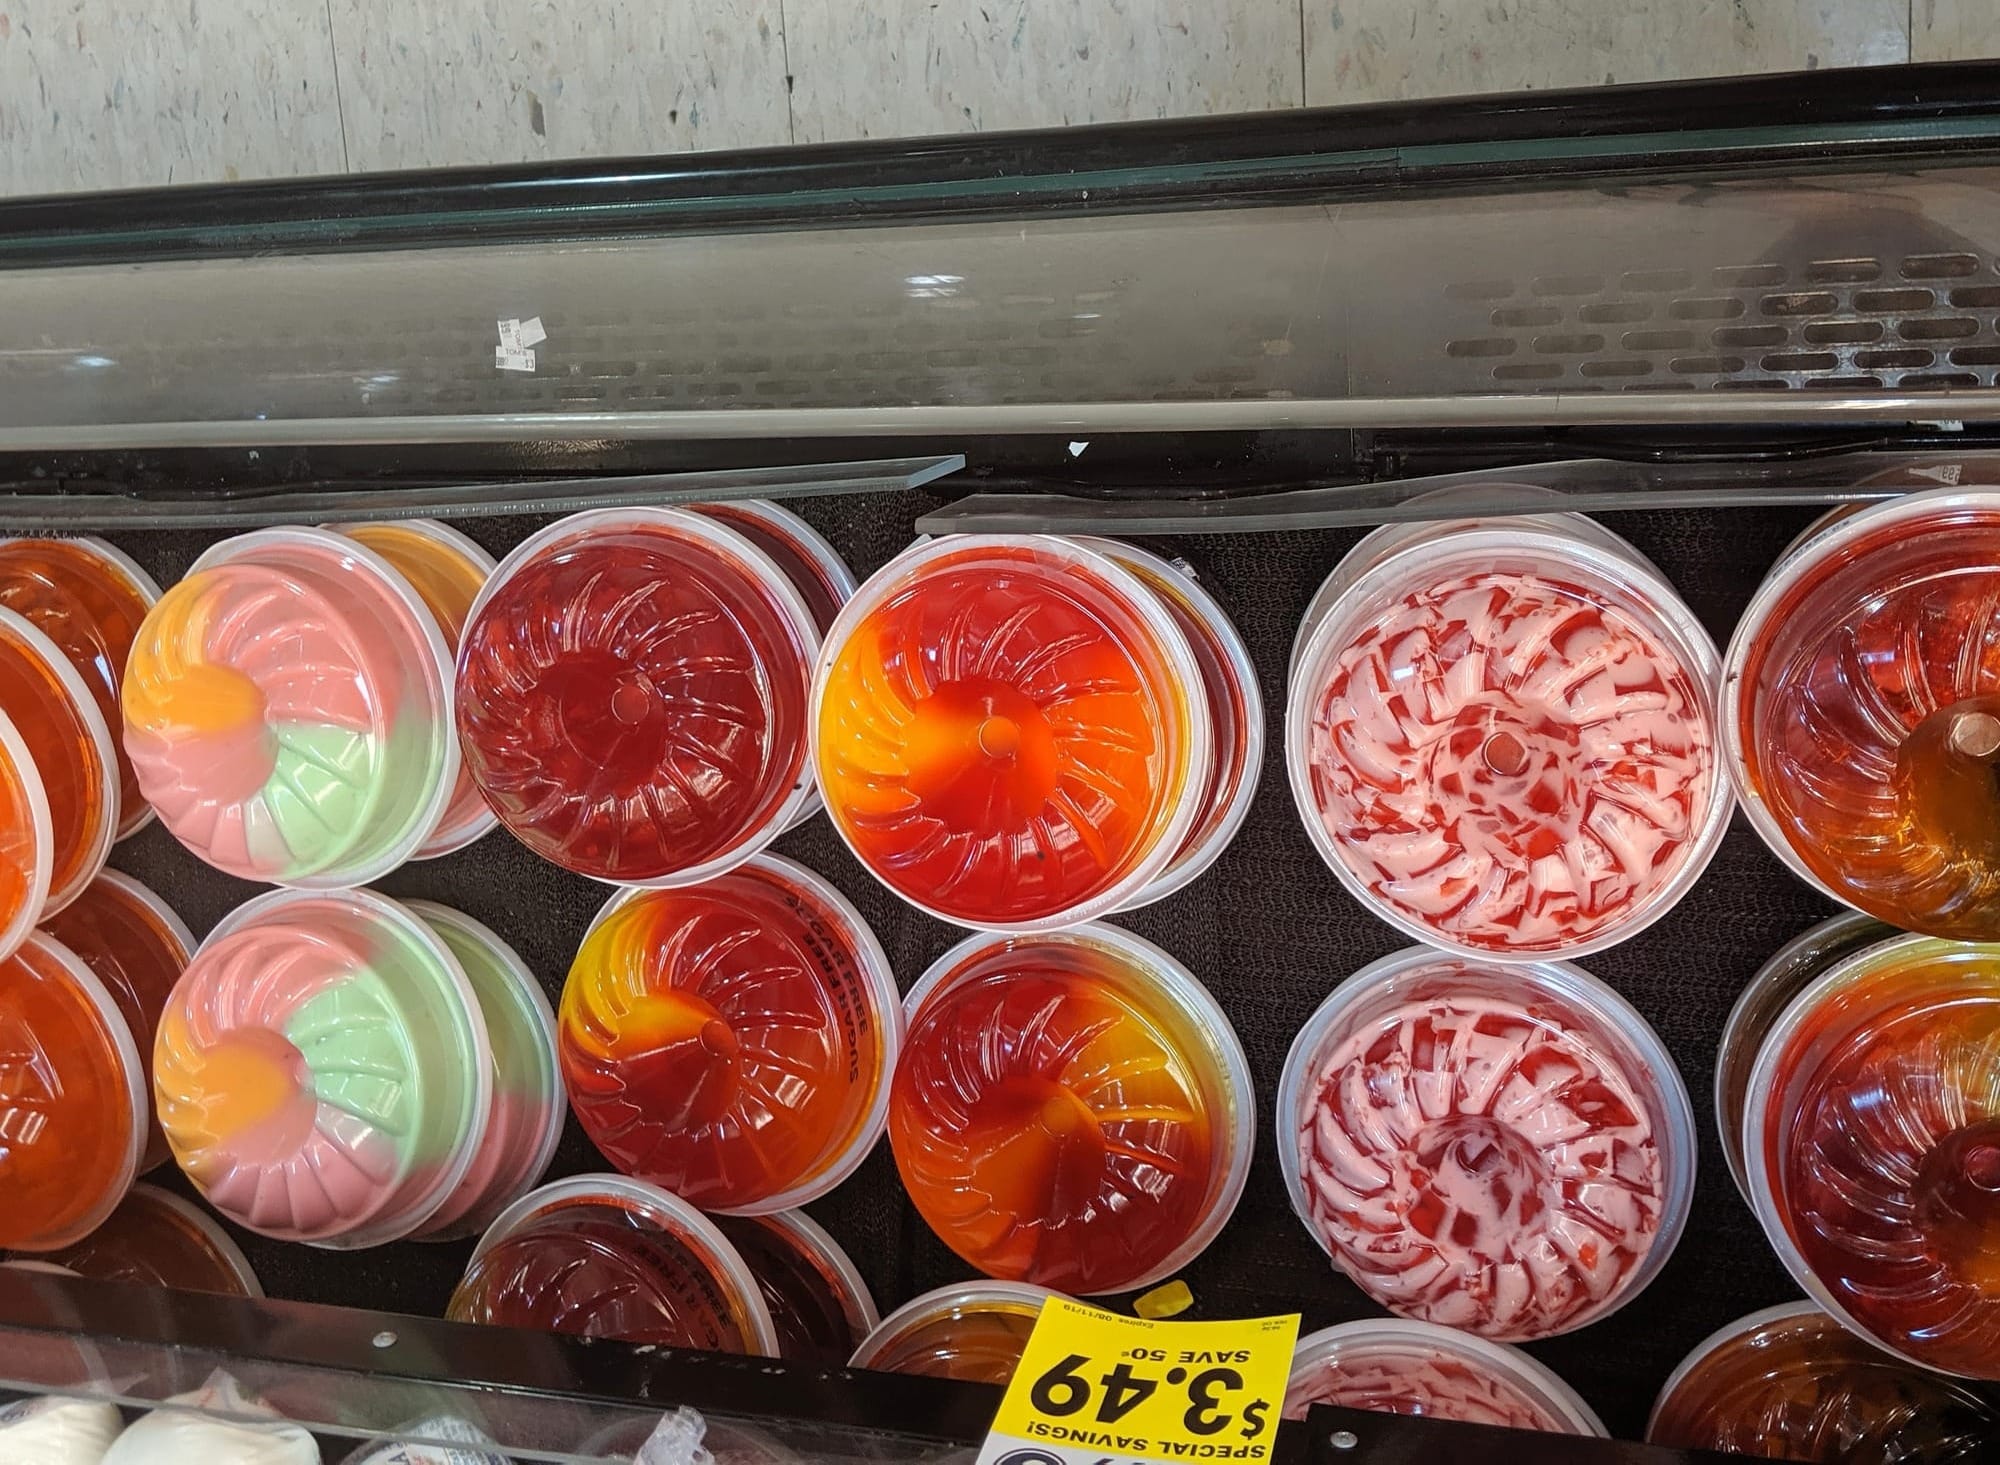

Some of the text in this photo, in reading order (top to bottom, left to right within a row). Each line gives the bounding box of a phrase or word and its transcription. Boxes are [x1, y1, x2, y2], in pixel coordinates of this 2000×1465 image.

[785, 896, 868, 1036] SUGAR FREE
[803, 932, 859, 1084] SUGAR FREE
[1063, 1304, 1154, 1329] Expires 08/11/19
[1178, 1350, 1250, 1363] SAVE
[1030, 1354, 1270, 1440] $3.49
[1026, 1421, 1266, 1458] SPECIAL SAVINGS!
